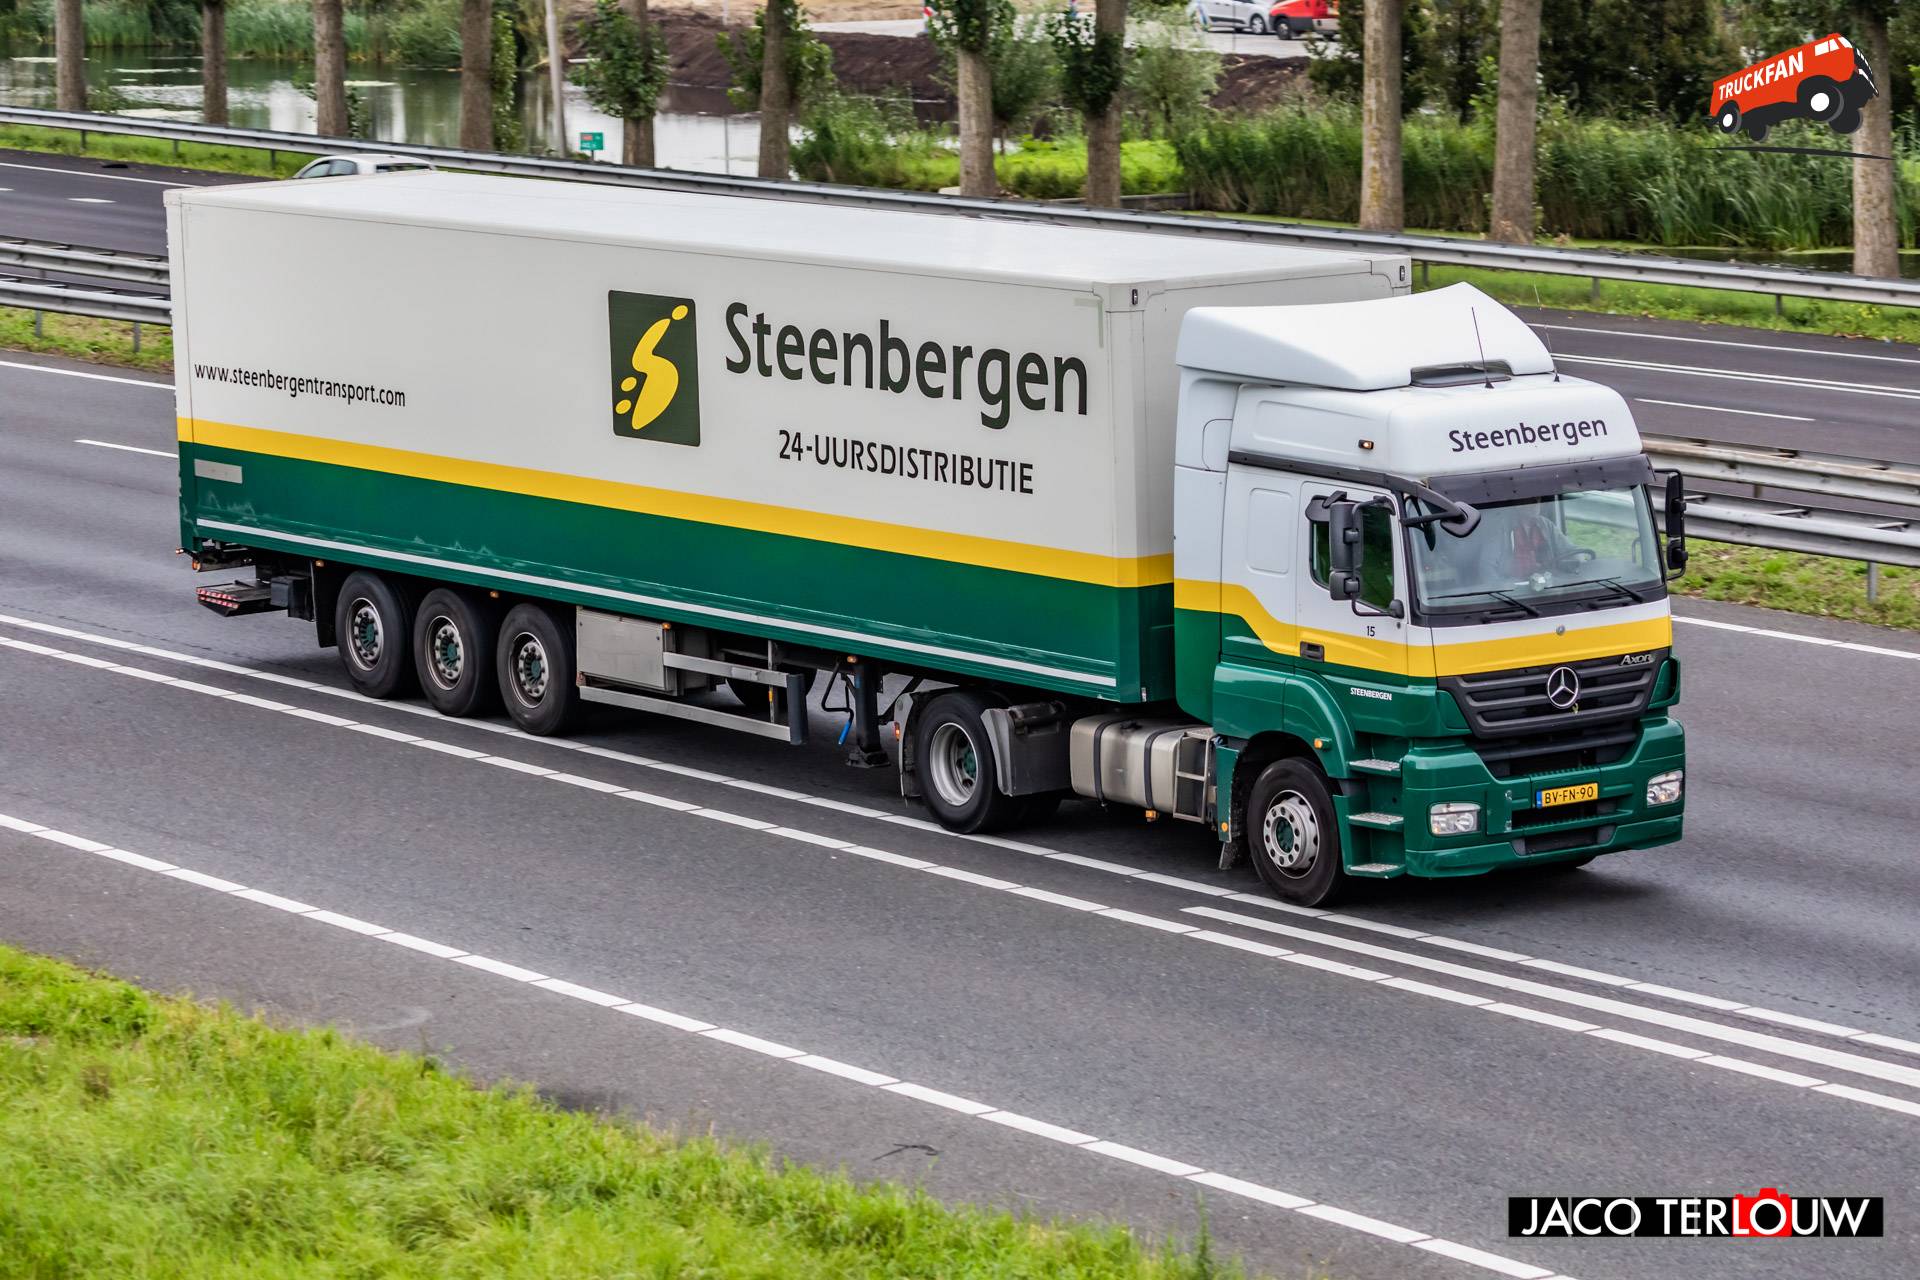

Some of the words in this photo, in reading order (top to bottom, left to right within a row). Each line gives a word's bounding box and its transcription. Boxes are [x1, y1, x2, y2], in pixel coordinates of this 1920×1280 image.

[725, 301, 1088, 430] Steenbergen
[194, 363, 406, 407] www.steenbergentransport.com
[1448, 419, 1608, 453] Steenbergen
[778, 429, 1034, 495] 24-UURSDISTRIBUTIE
[1366, 625, 1376, 637] 15
[1350, 687, 1392, 700] STEENBERGEN
[1544, 786, 1594, 804] BV-FN-90
